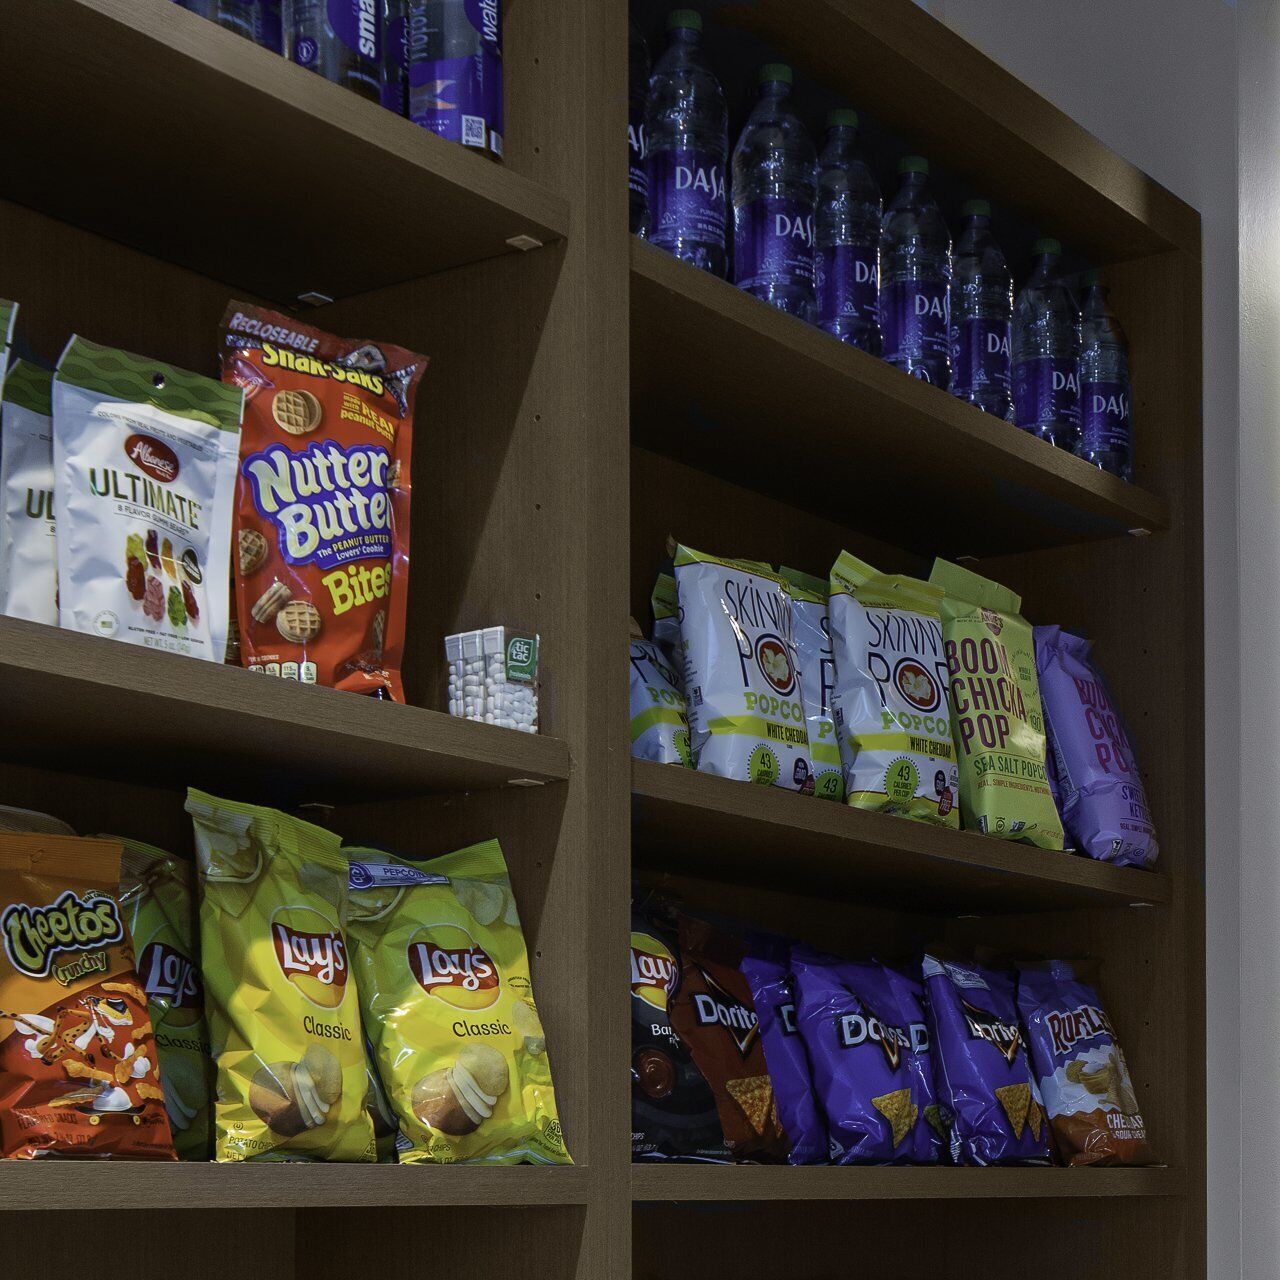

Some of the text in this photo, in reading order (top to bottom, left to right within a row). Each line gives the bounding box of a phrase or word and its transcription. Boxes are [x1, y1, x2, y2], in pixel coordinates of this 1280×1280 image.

[229, 312, 320, 352] RECLOSEABLE
[262, 342, 384, 396] Snak-Saks
[341, 408, 376, 429] peanut
[130, 440, 175, 474] Albanese
[249, 445, 388, 513] Nutter
[89, 467, 203, 530] ULTIMATE
[124, 506, 152, 521] FLAVOR
[317, 534, 390, 559] The PEANUT BUTTER
[336, 543, 385, 561] Lovers' Cookie
[321, 562, 392, 617] Bites
[866, 610, 944, 656] SKINNY
[512, 650, 529, 662] tac
[516, 641, 530, 654] tic
[944, 637, 1013, 685] BOOM
[951, 677, 1028, 723] CHICKA
[766, 722, 786, 742] WHITE
[958, 713, 1011, 755] POP
[759, 752, 772, 769] 43
[909, 736, 953, 760] WHITE CHEDDAR
[897, 765, 910, 781] 43
[973, 756, 1020, 777] SEA SALT
[823, 777, 838, 793] 43
[893, 780, 912, 791] CALORIES
[893, 787, 911, 798] PER CUP
[11, 896, 115, 970] Cheetos
[280, 922, 346, 985] Lay's
[51, 951, 108, 986] Crunchy
[415, 942, 494, 992] Lay's
[303, 1015, 352, 1041] Classic
[451, 1019, 513, 1038] Classic
